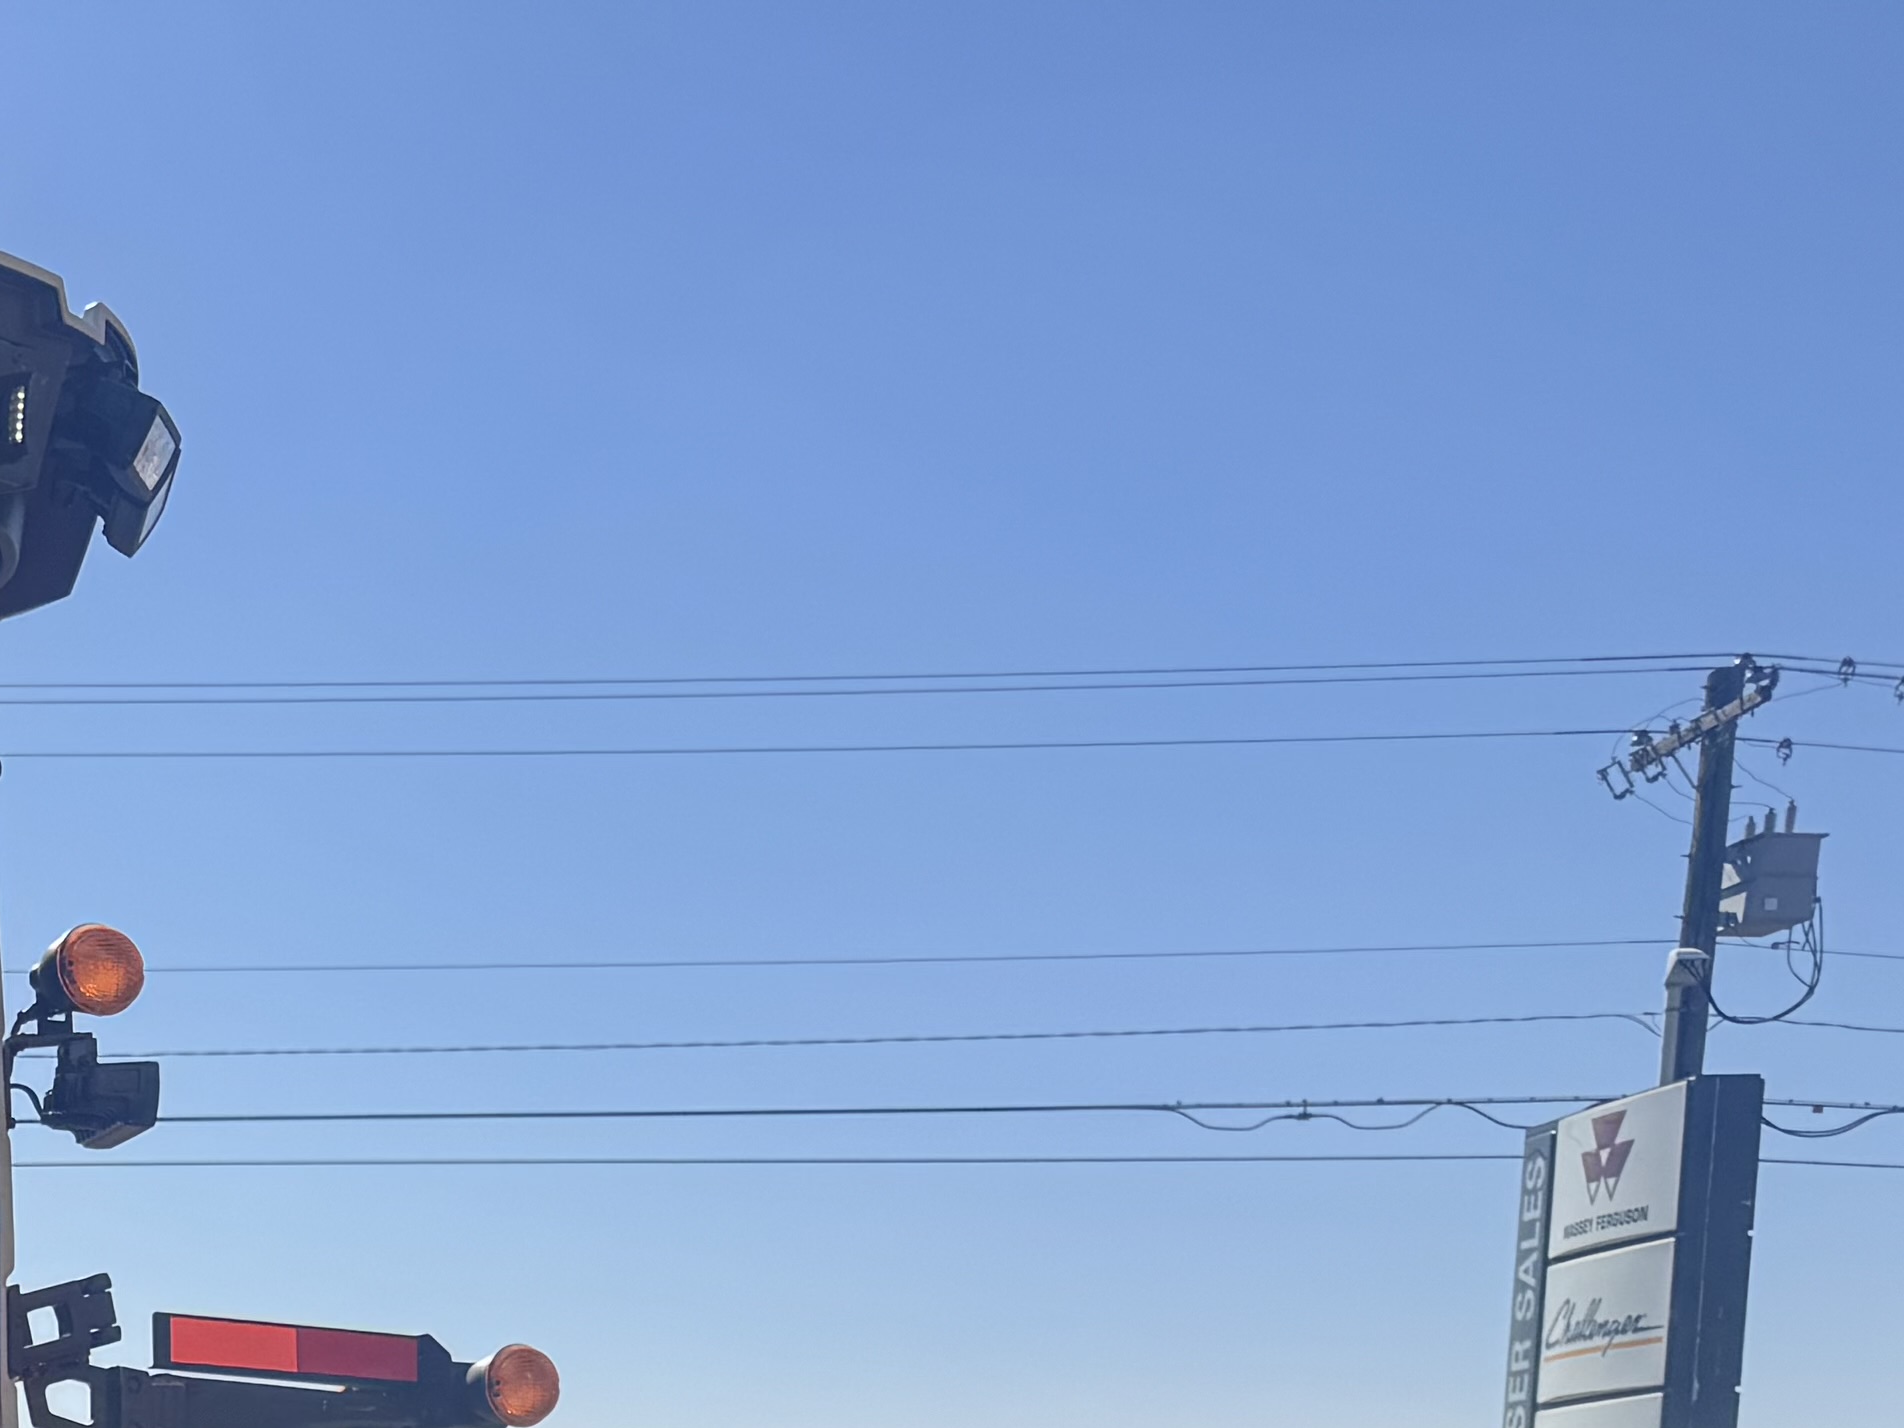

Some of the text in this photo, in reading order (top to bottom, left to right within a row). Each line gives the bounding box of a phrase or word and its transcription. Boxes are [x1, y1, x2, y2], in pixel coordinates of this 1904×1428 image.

[1515, 1153, 1546, 1321] SALES
[1563, 1205, 1649, 1239] MASSEY FERGUSON
[1545, 1297, 1664, 1357] Challenger
